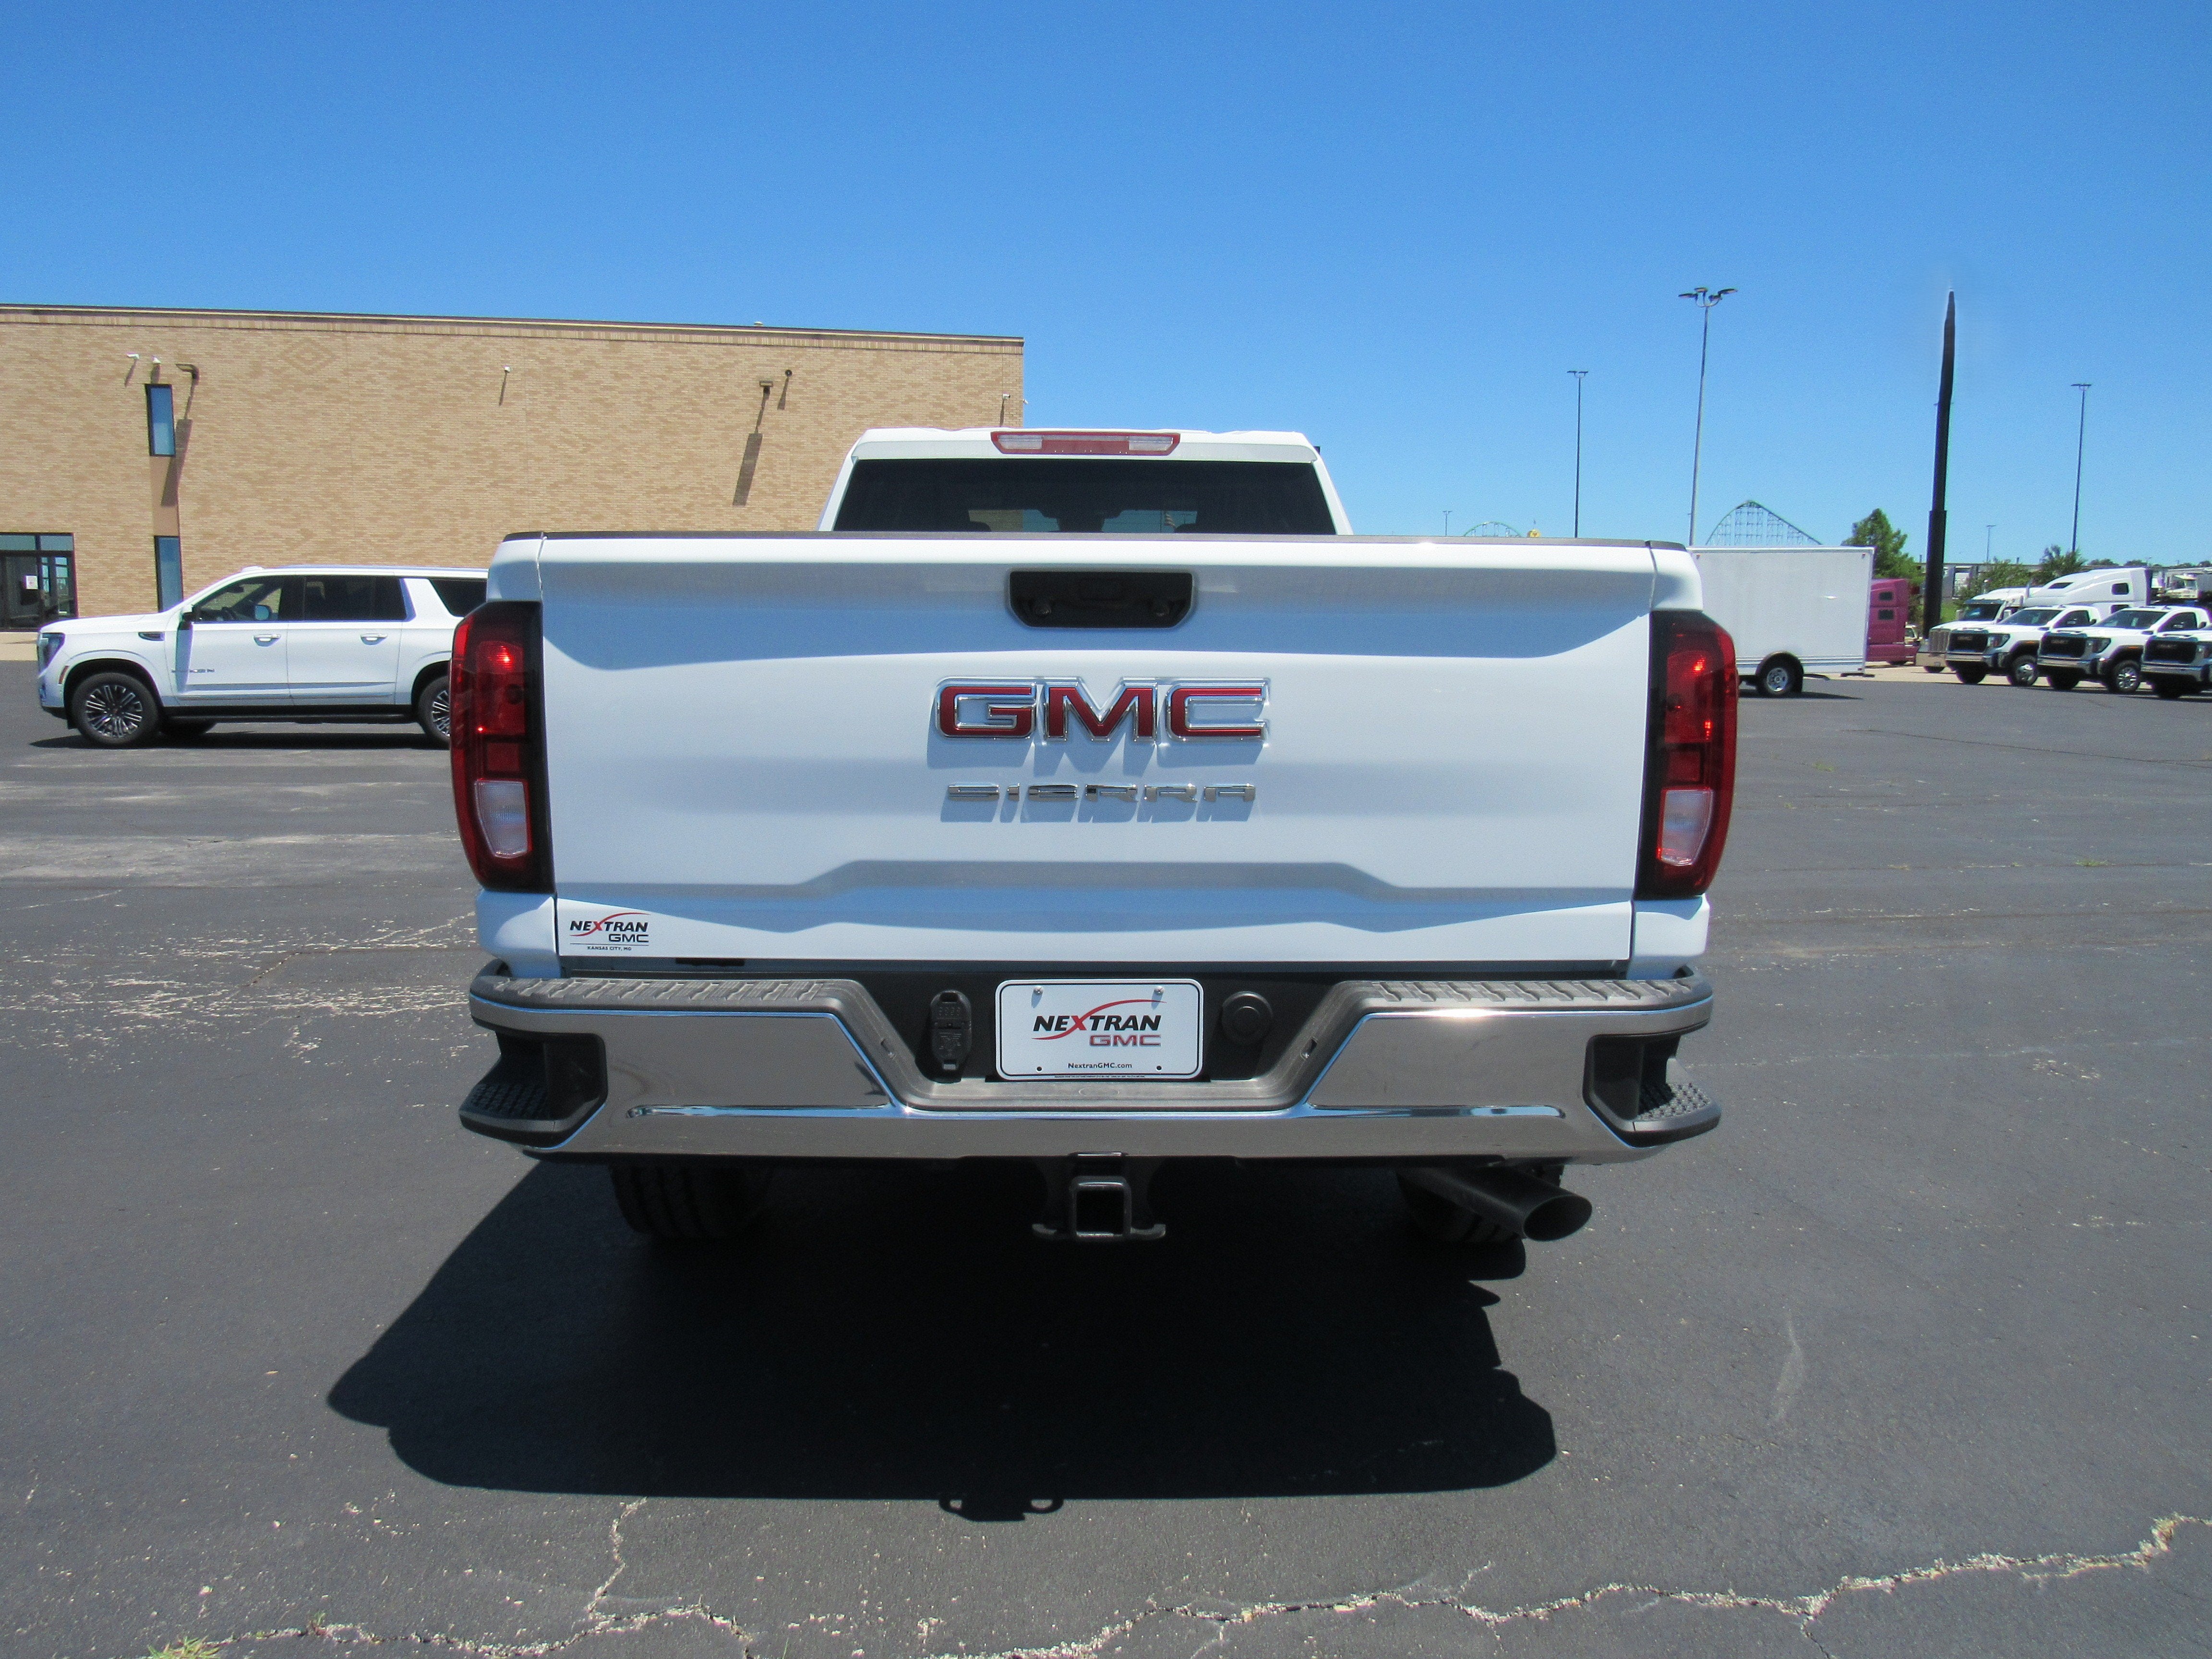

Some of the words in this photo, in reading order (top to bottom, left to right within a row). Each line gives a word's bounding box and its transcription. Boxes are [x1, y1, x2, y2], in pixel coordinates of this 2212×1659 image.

[937, 681, 1266, 741] GMC
[948, 783, 1256, 802] SIERRA
[570, 920, 648, 932] NEXTRAN
[608, 934, 649, 942] GMC
[1033, 1014, 1162, 1032] NEXTRAN
[1089, 1034, 1162, 1046] GMC
